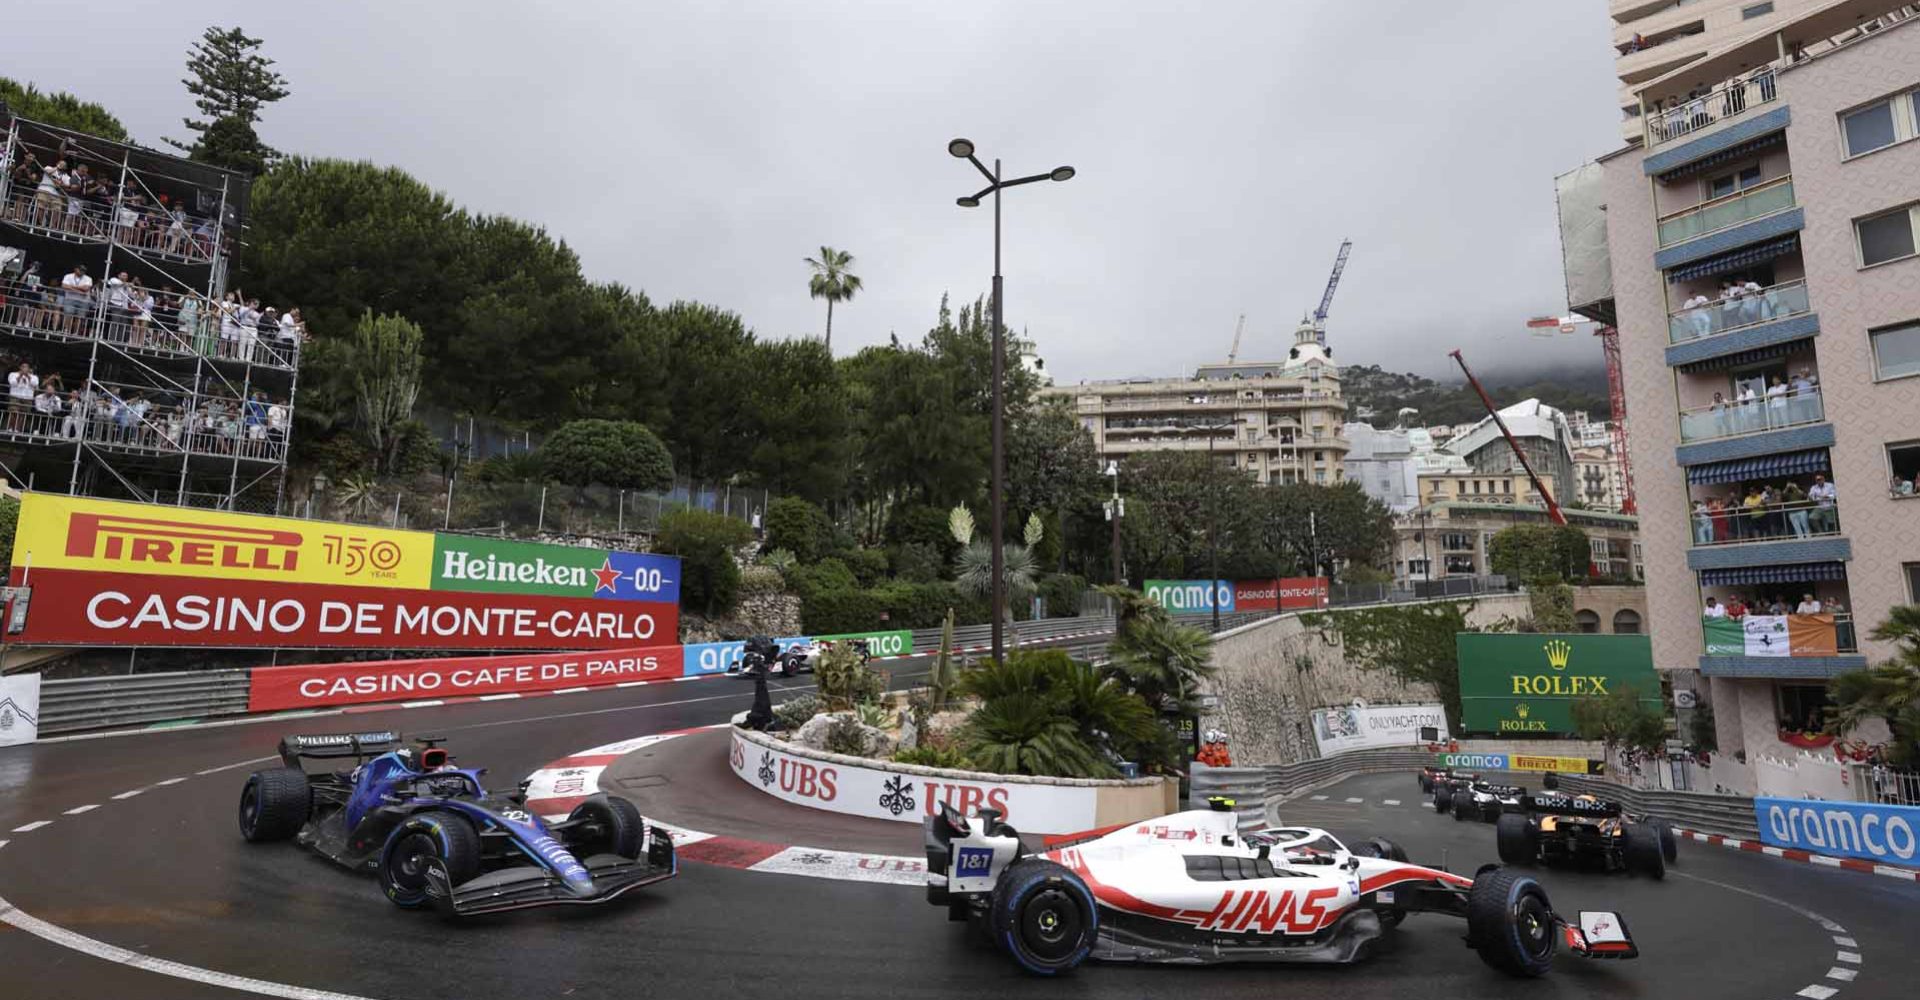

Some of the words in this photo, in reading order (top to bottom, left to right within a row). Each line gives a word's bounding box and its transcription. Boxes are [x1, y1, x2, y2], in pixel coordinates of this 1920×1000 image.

[65, 511, 304, 572] PIRELLI
[322, 534, 402, 577] 150
[371, 571, 398, 579] YEARS
[441, 550, 588, 587] Heineken
[1237, 590, 1265, 600] CASINO
[1266, 590, 1276, 599] DE
[86, 590, 306, 633] CASINO
[318, 601, 384, 634] DE
[394, 603, 655, 640] MONTE-CARLO
[299, 673, 442, 698] CASINO
[450, 665, 533, 687] CAFE
[541, 662, 580, 680] DE
[586, 656, 659, 676] PARIS
[1511, 675, 1609, 695] ROLEX
[1180, 720, 1193, 731] 19
[1369, 714, 1441, 730] ONLYYACHT.COM
[1501, 720, 1547, 731] ROLEX
[297, 734, 352, 745] WILLIAMS
[357, 732, 393, 743] ACING
[1445, 755, 1502, 768] aramco
[1517, 756, 1557, 770] PIRELLI
[779, 757, 838, 802] UBS
[923, 782, 1009, 823] UBS
[1769, 805, 1915, 860] aramco
[857, 858, 926, 872] UB
[960, 853, 991, 870] 1&1
[1060, 848, 1082, 870] 47
[1199, 887, 1340, 933] HAAS
